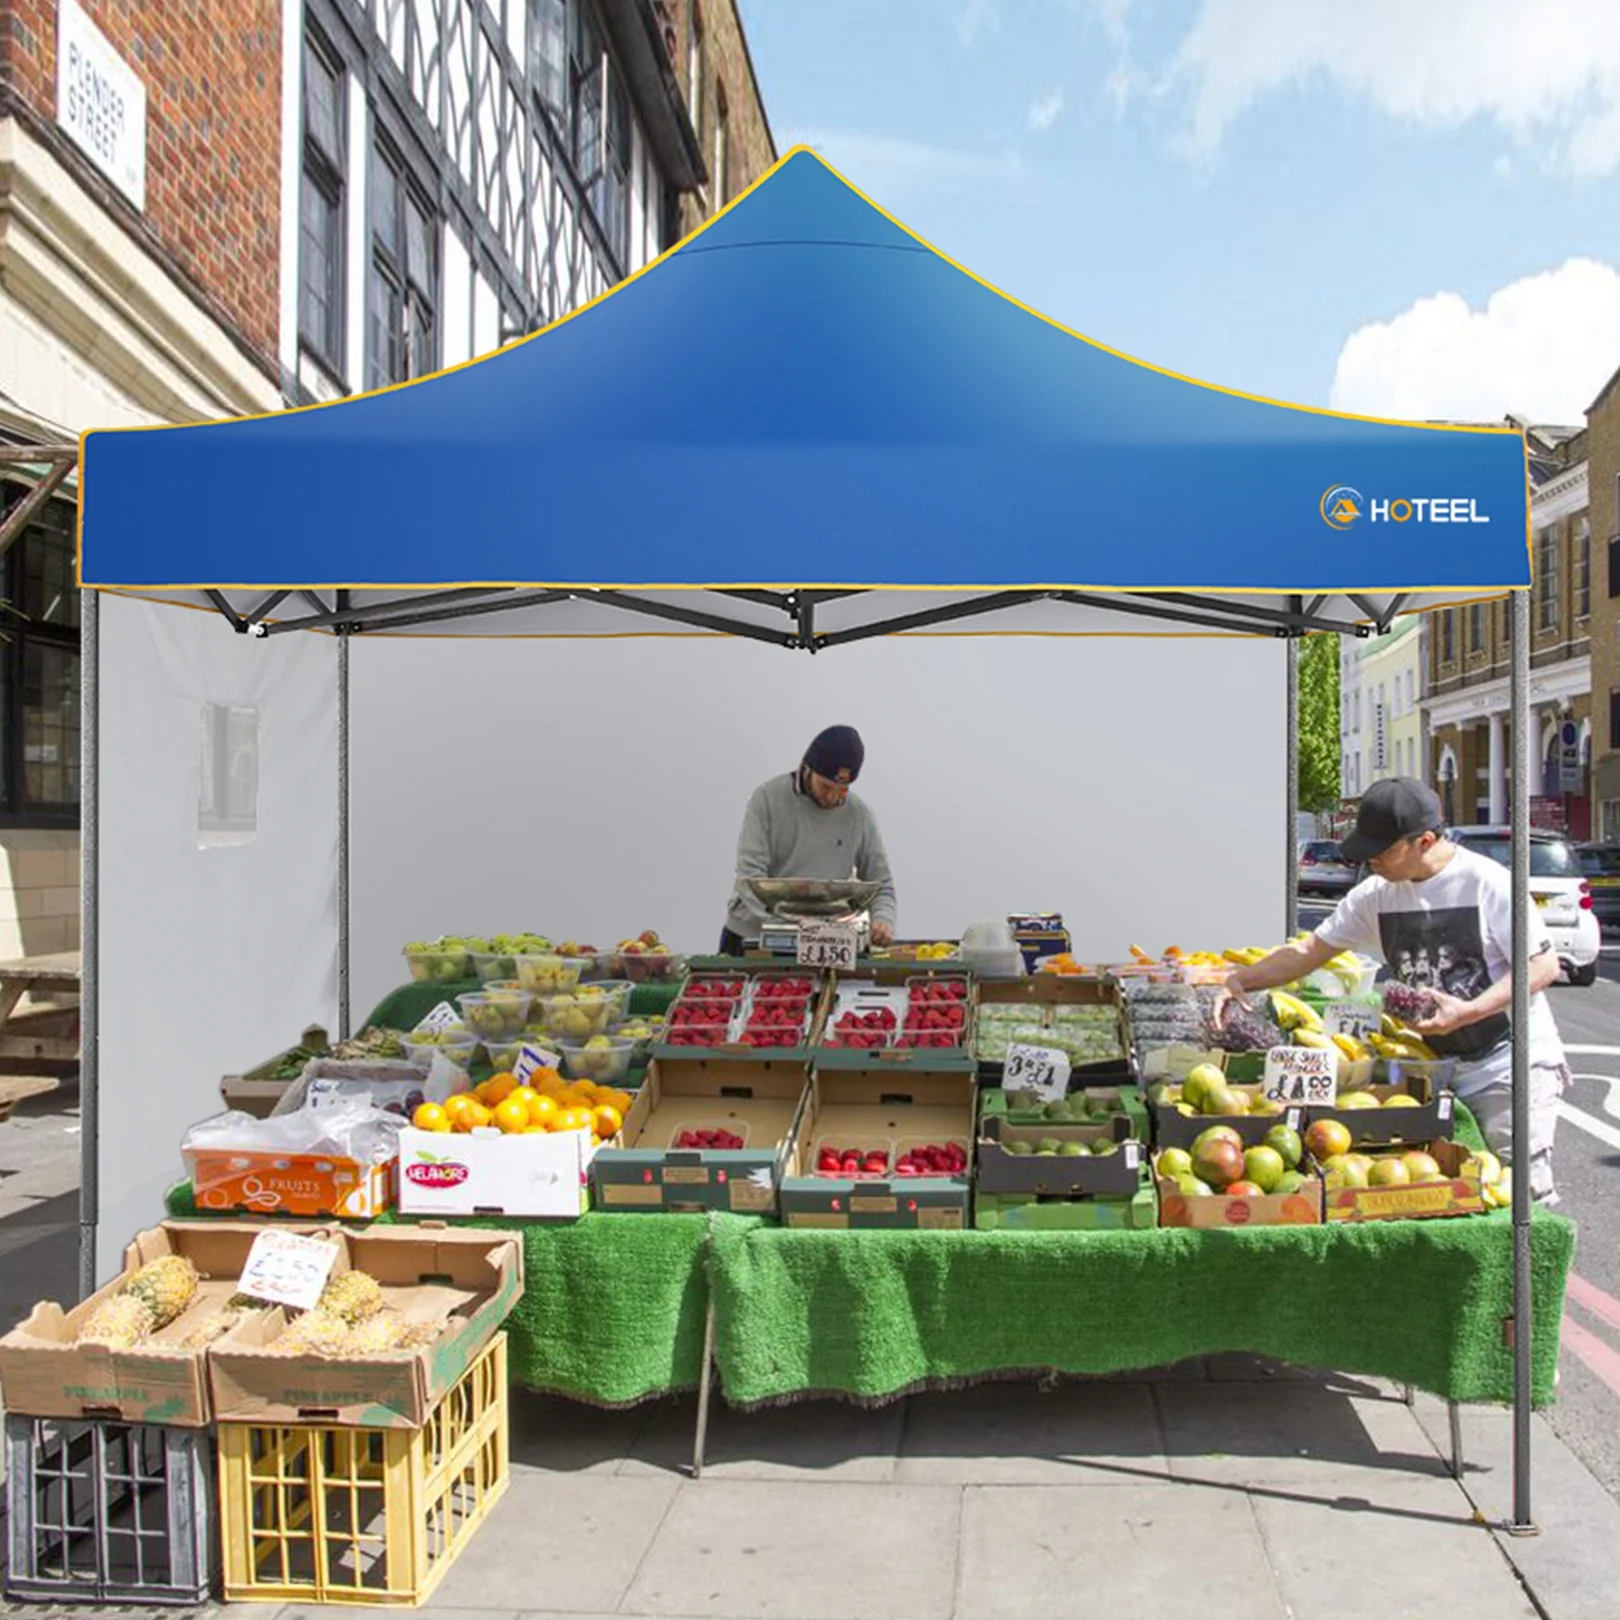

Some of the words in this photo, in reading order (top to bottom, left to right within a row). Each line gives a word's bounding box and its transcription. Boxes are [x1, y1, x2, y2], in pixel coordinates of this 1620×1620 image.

[67, 84, 116, 164] STREET
[69, 40, 125, 134] PLENDER
[1371, 498, 1490, 523] HOTEEL
